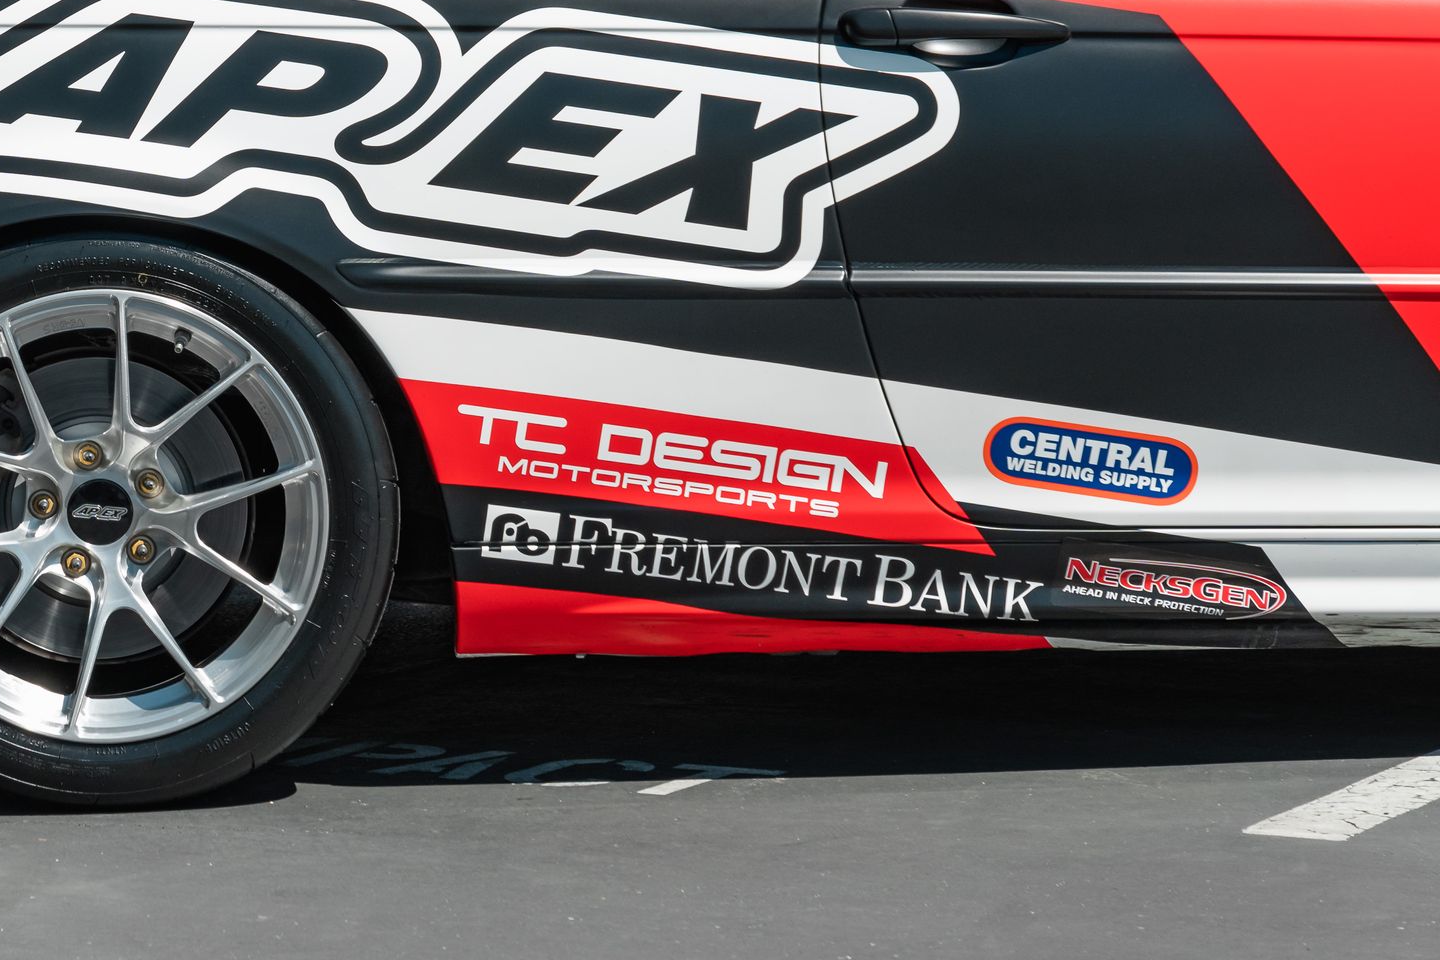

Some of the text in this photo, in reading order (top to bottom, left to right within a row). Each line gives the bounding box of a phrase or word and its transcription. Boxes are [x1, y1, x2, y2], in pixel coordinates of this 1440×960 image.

[458, 403, 888, 499] TC DESIGN
[1007, 456, 1174, 493] WELDING SUPPLY
[1010, 429, 1174, 476] CENTRAL
[497, 455, 839, 518] MOTORSPORTS
[562, 514, 863, 601] FREMONT
[866, 554, 1044, 621] BANK
[1062, 584, 1224, 616] AHEAD IN NECK PROTECTION
